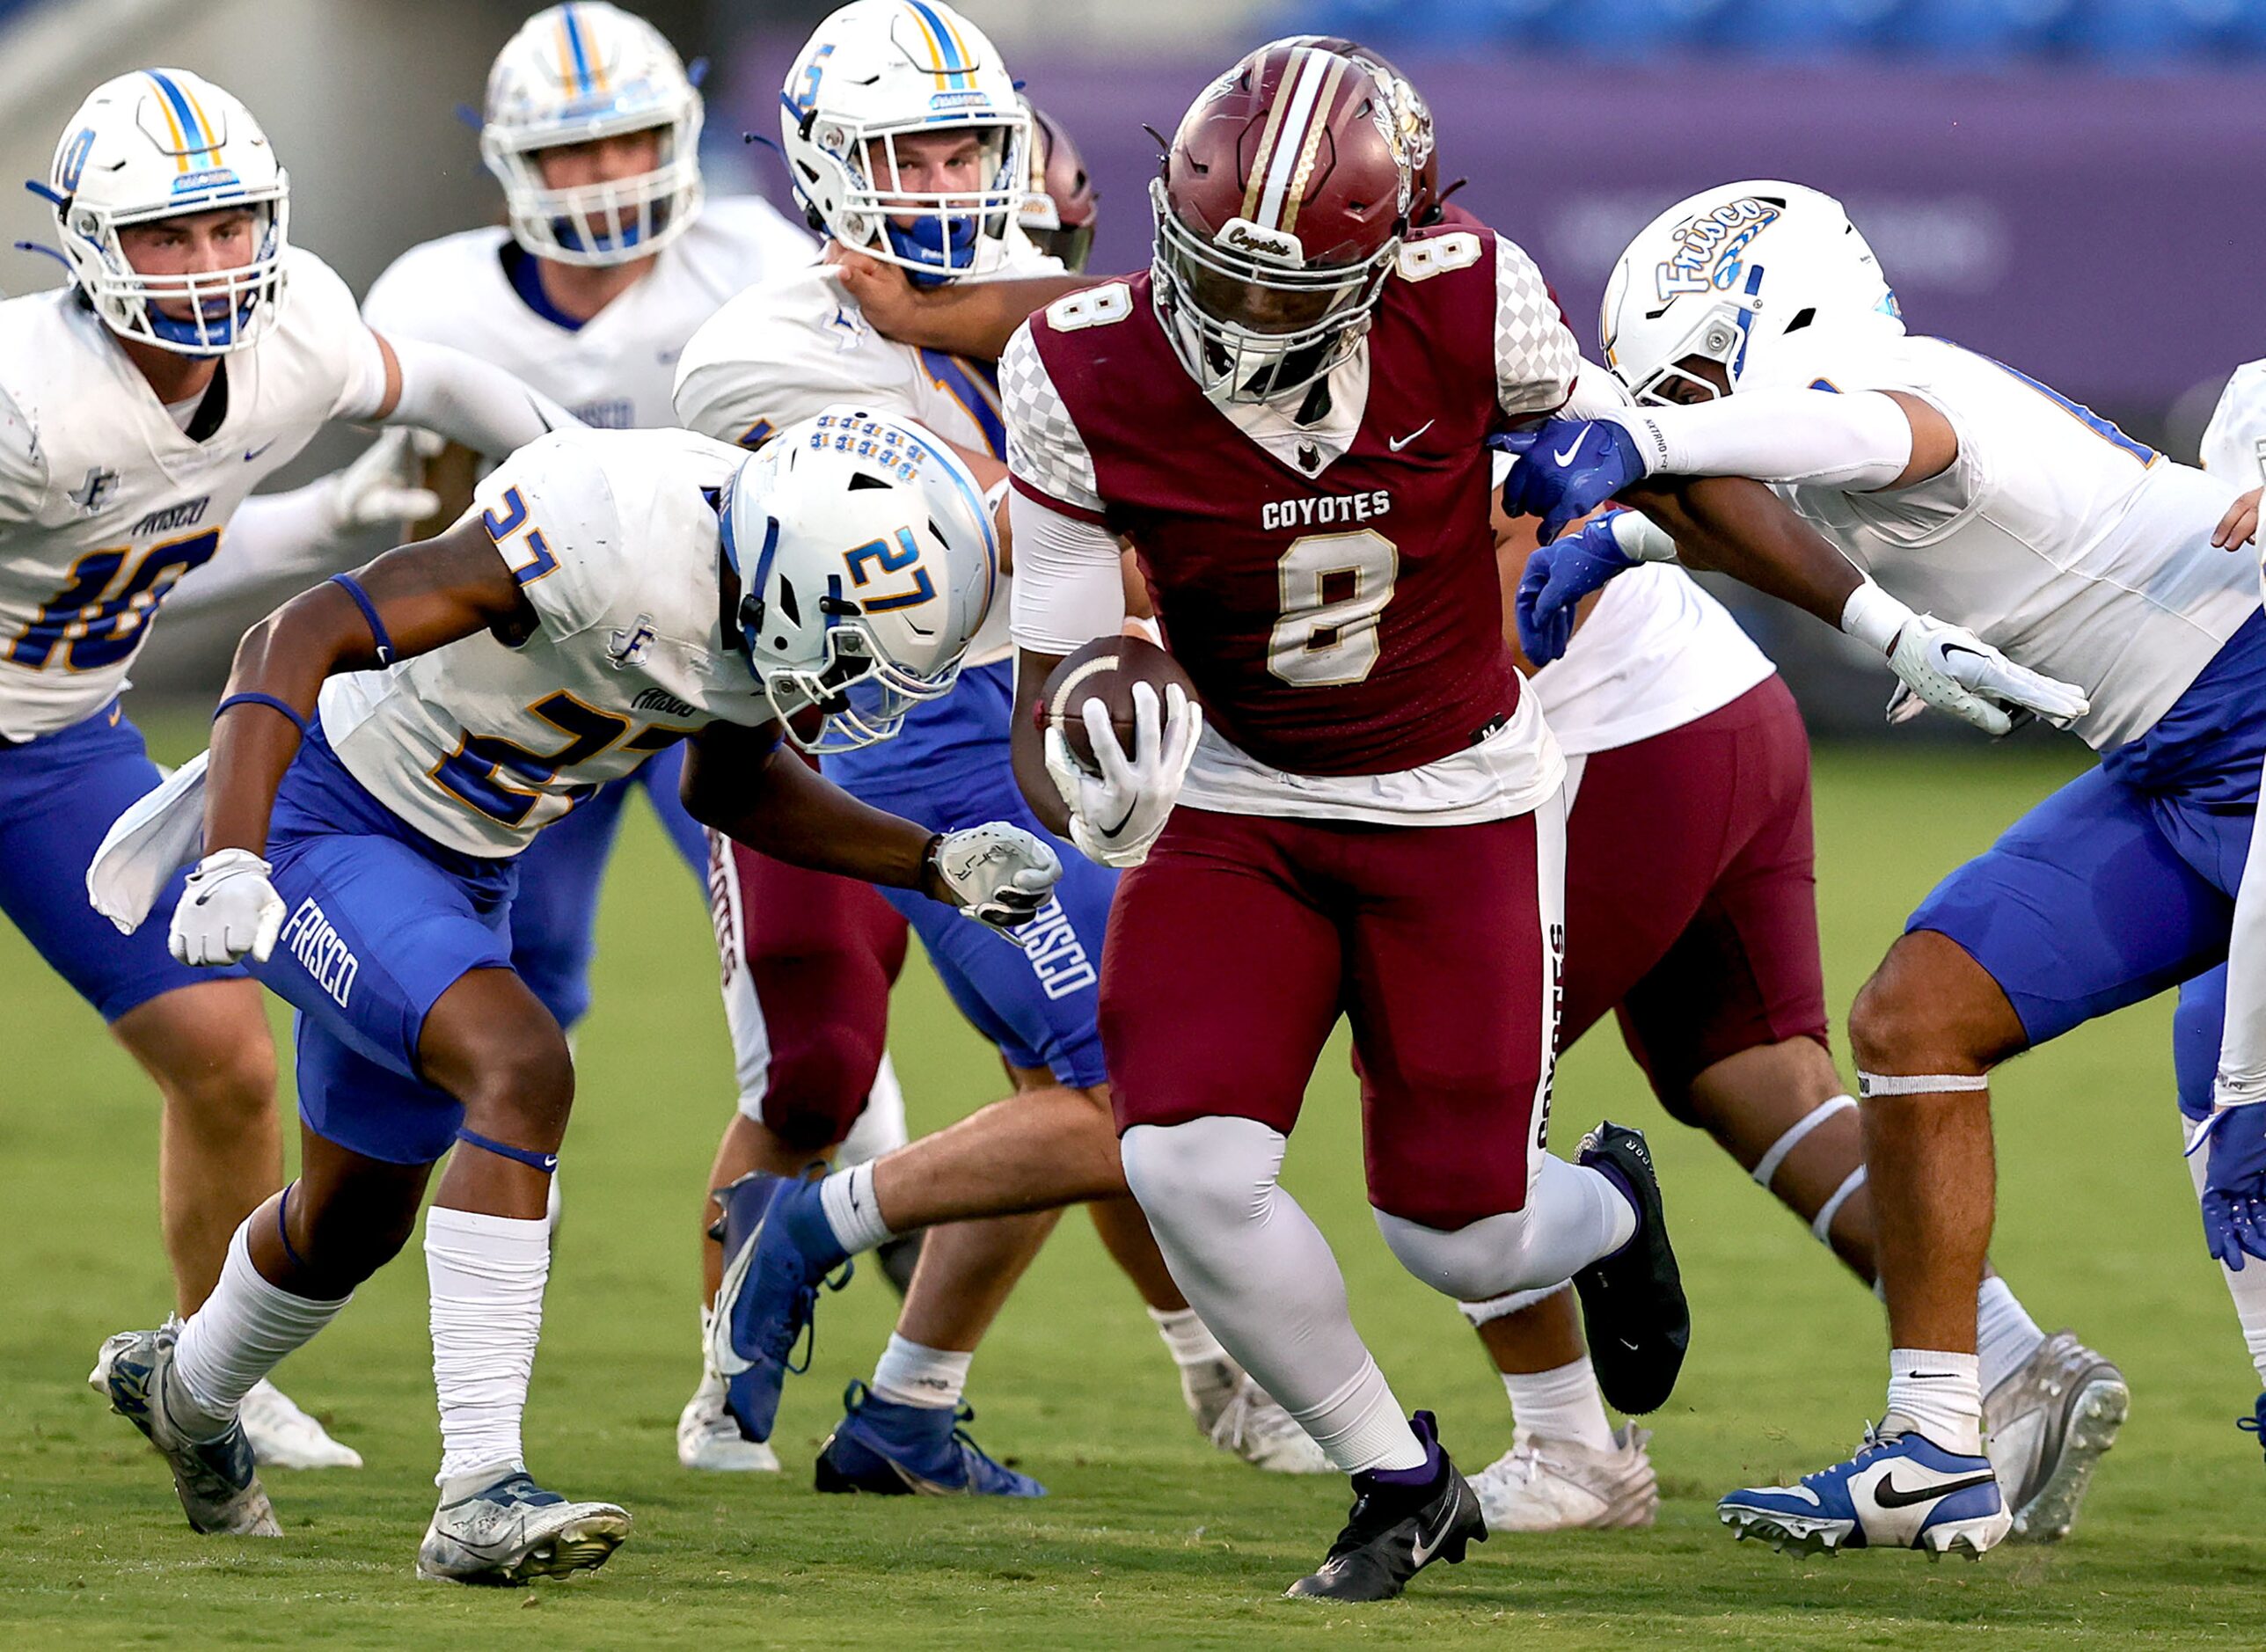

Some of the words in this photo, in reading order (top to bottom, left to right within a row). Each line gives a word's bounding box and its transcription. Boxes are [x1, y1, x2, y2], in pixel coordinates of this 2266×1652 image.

[1229, 227, 1290, 257] Coyotes
[1656, 199, 1762, 302] Frisco
[1046, 281, 1133, 333] 8
[1643, 418, 1667, 453] NXTRND
[132, 496, 210, 537] FRISCO
[1262, 490, 1391, 530] COYOTES
[5, 524, 223, 673] 10
[842, 525, 939, 615] 27
[1267, 528, 1399, 688] 8
[631, 687, 698, 719] FRISCO
[281, 895, 359, 1008] FRISCO
[1014, 894, 1097, 1000] RISCO
